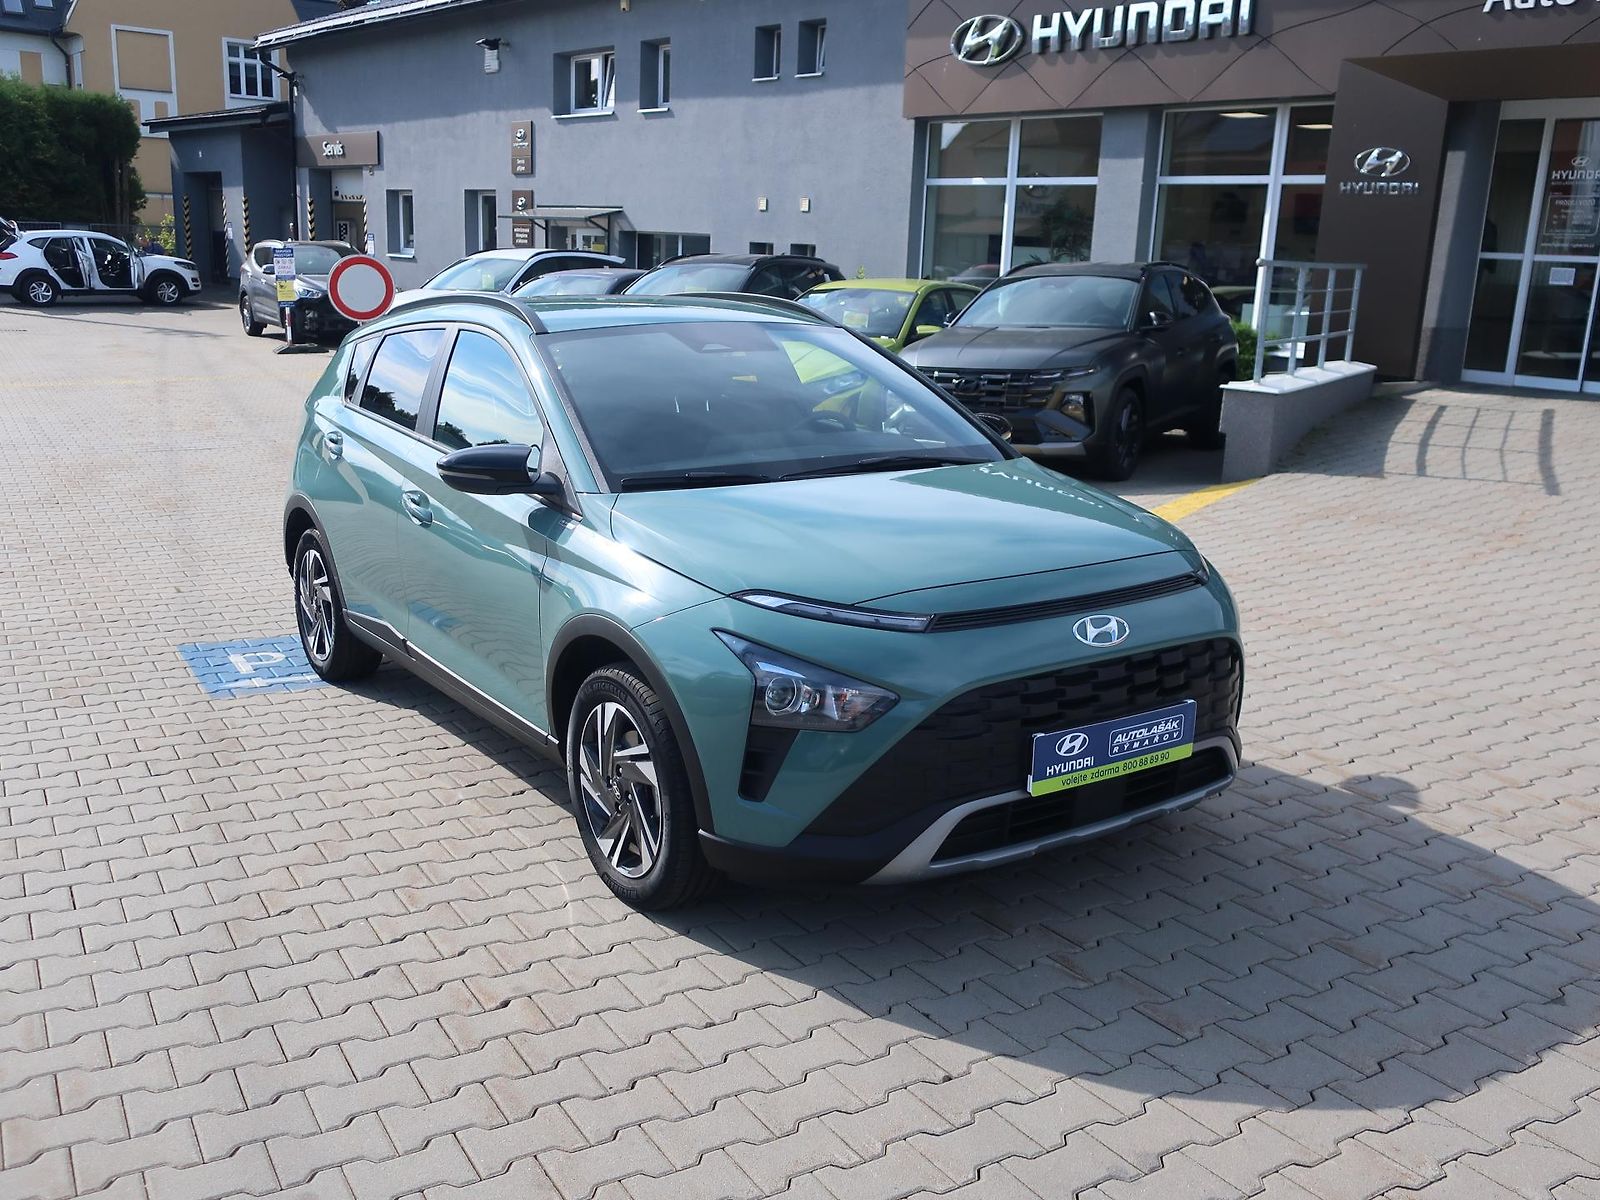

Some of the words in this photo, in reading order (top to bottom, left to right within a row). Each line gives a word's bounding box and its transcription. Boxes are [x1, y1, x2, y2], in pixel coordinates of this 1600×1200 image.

[1031, 0, 1251, 54] HYUNDAI
[322, 140, 344, 156] Servis
[1340, 182, 1419, 195] HYUNDAI
[1113, 719, 1179, 744] AUTOLAŠÁK
[1046, 756, 1094, 777] HYUNDAI
[1061, 773, 1088, 787] volejte
[1090, 766, 1119, 779] zdarma
[1122, 759, 1138, 772] 800
[1139, 756, 1149, 767] 88
[1149, 754, 1159, 764] 89
[1160, 751, 1170, 762] 90
